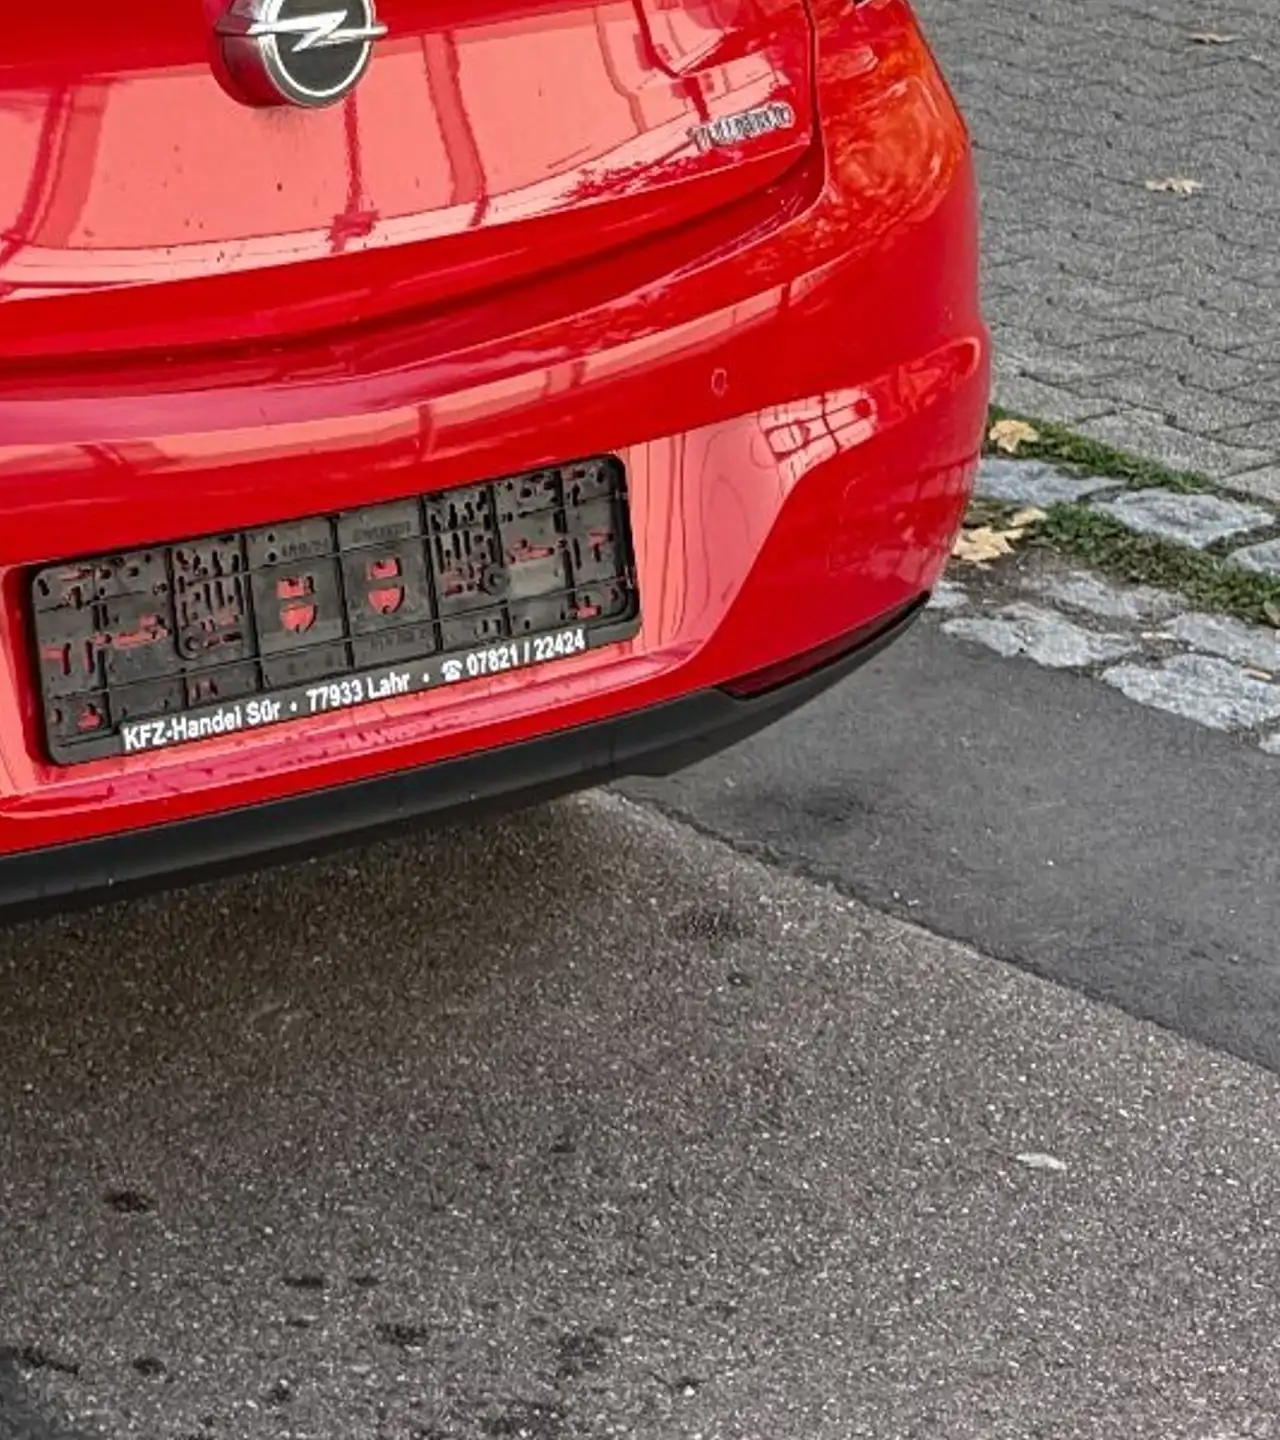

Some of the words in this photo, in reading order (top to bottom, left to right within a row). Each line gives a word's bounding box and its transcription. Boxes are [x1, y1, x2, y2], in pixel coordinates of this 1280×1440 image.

[122, 705, 242, 750] KFZ-Handel
[306, 679, 363, 712] 77933
[366, 671, 410, 699] Lahr
[466, 643, 518, 676] 07821
[534, 628, 585, 661] 22424
